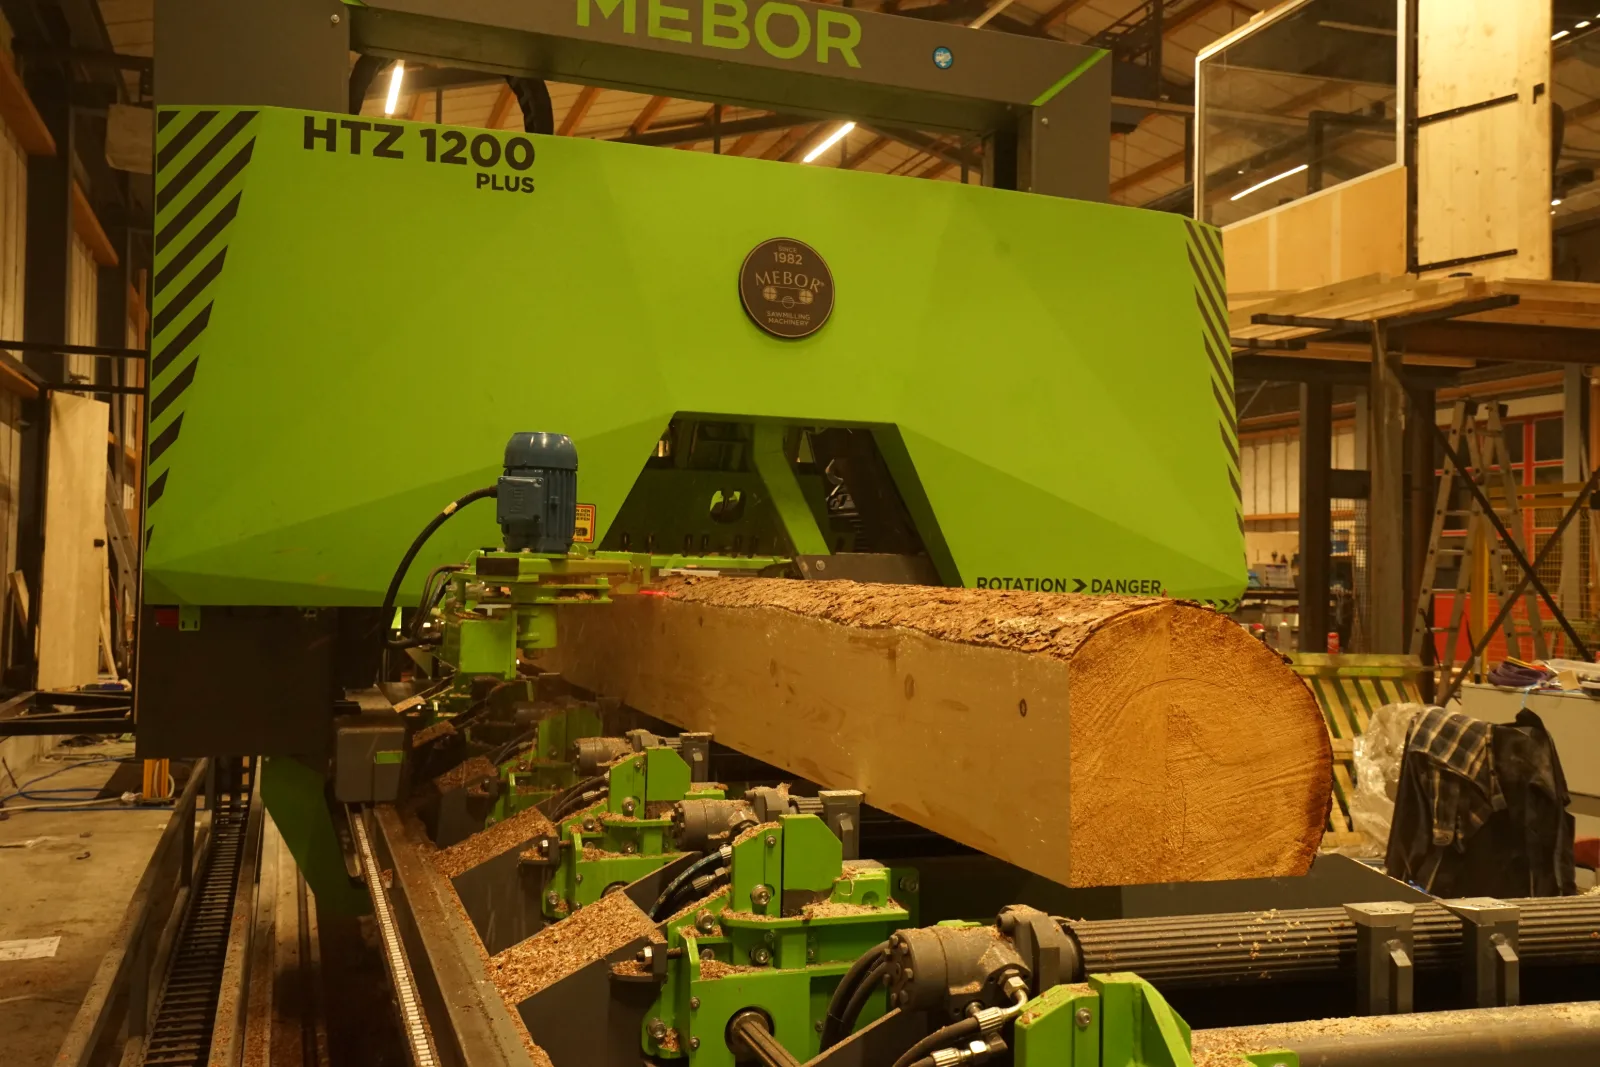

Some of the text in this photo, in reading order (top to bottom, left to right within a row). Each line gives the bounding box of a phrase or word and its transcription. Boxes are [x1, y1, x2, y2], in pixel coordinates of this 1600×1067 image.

[303, 116, 535, 171] HTZ 1200
[476, 172, 535, 193] PLUS
[778, 245, 798, 253] SINCE
[773, 252, 802, 265] 1982
[766, 311, 810, 320] SAWMILLING
[768, 317, 809, 326] MACHINERY
[977, 577, 1161, 594] ROTATION DANGER
